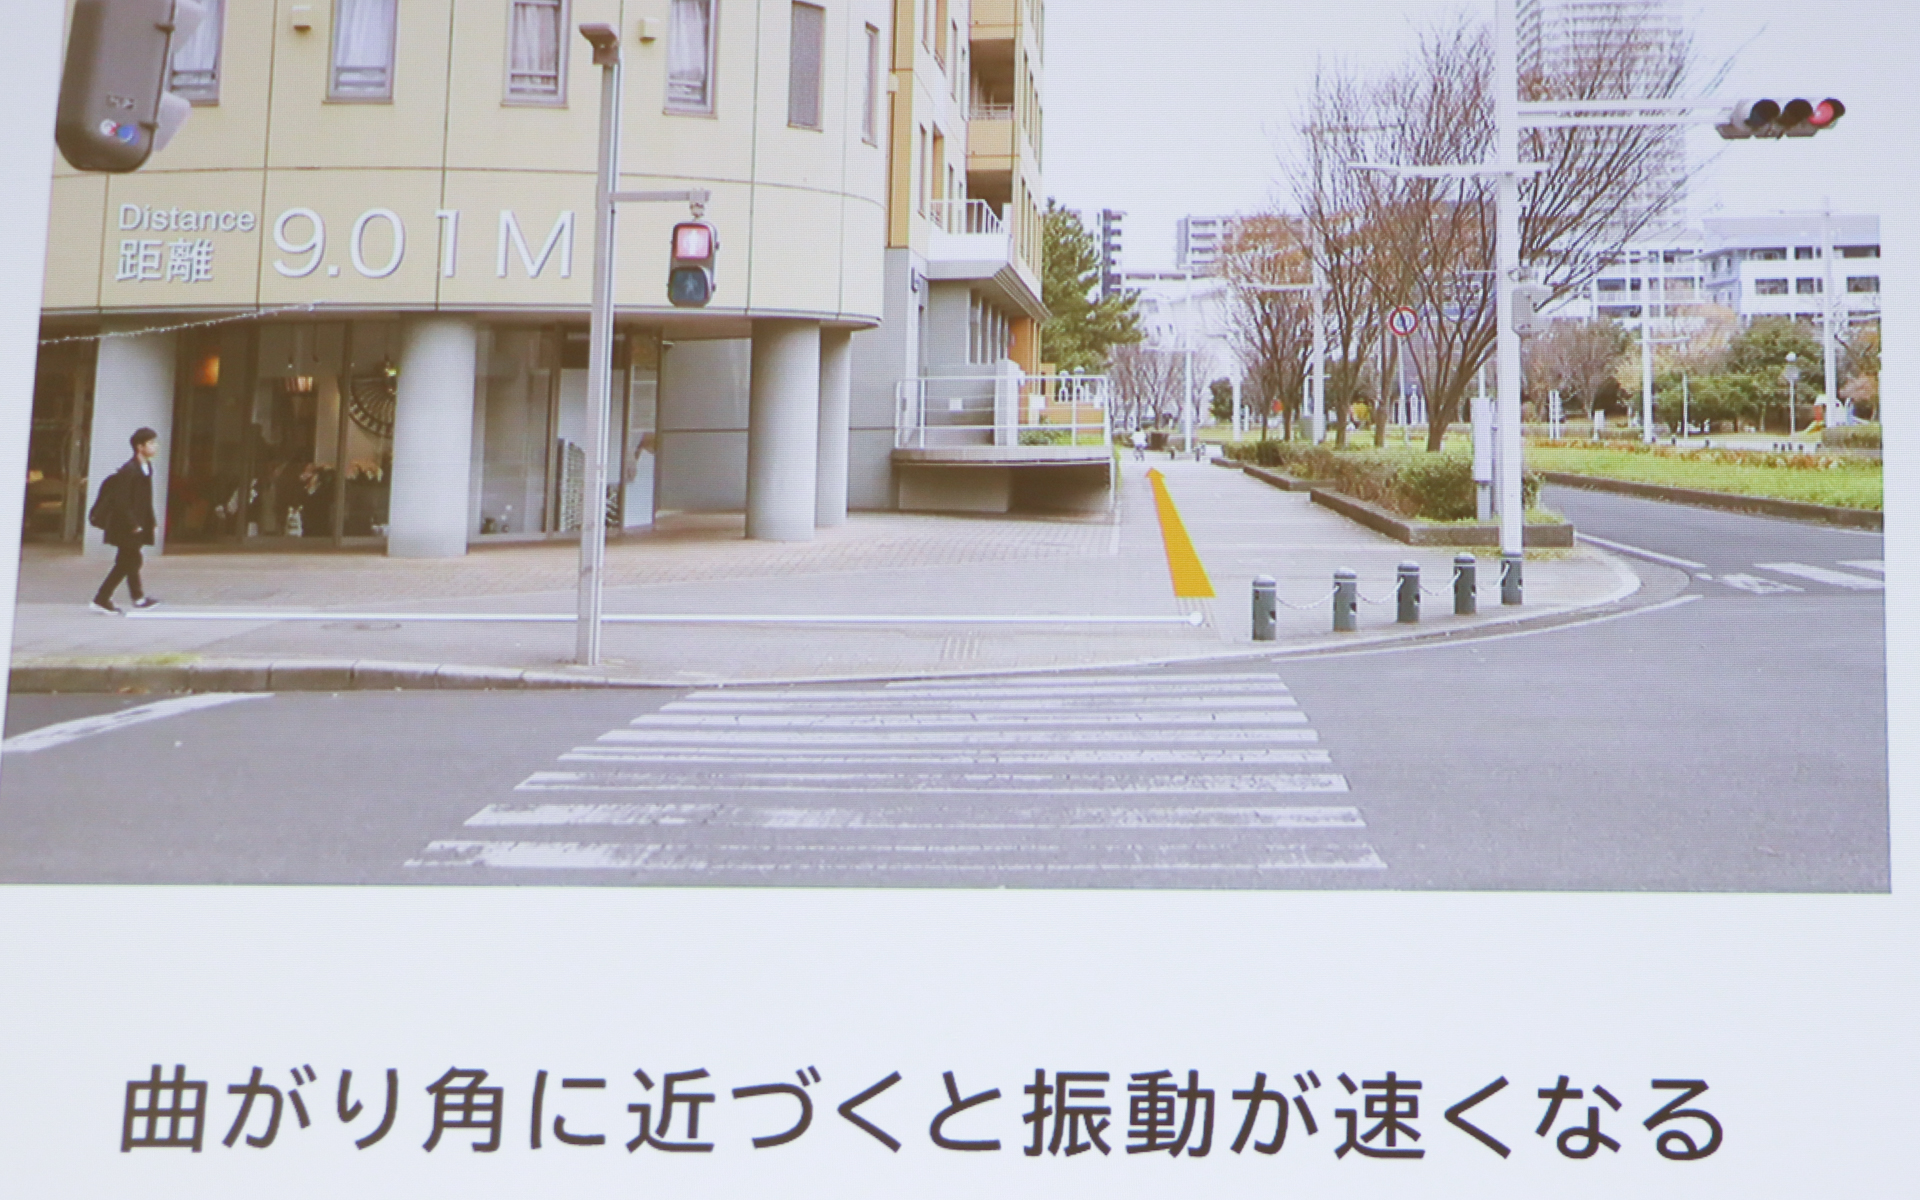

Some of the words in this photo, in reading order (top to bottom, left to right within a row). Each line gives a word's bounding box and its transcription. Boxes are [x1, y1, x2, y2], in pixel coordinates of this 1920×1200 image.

[118, 203, 257, 232] Distance
[114, 238, 215, 284] 距離
[120, 1064, 1724, 1161] 曲がり角に近づくと振動が速くなる
